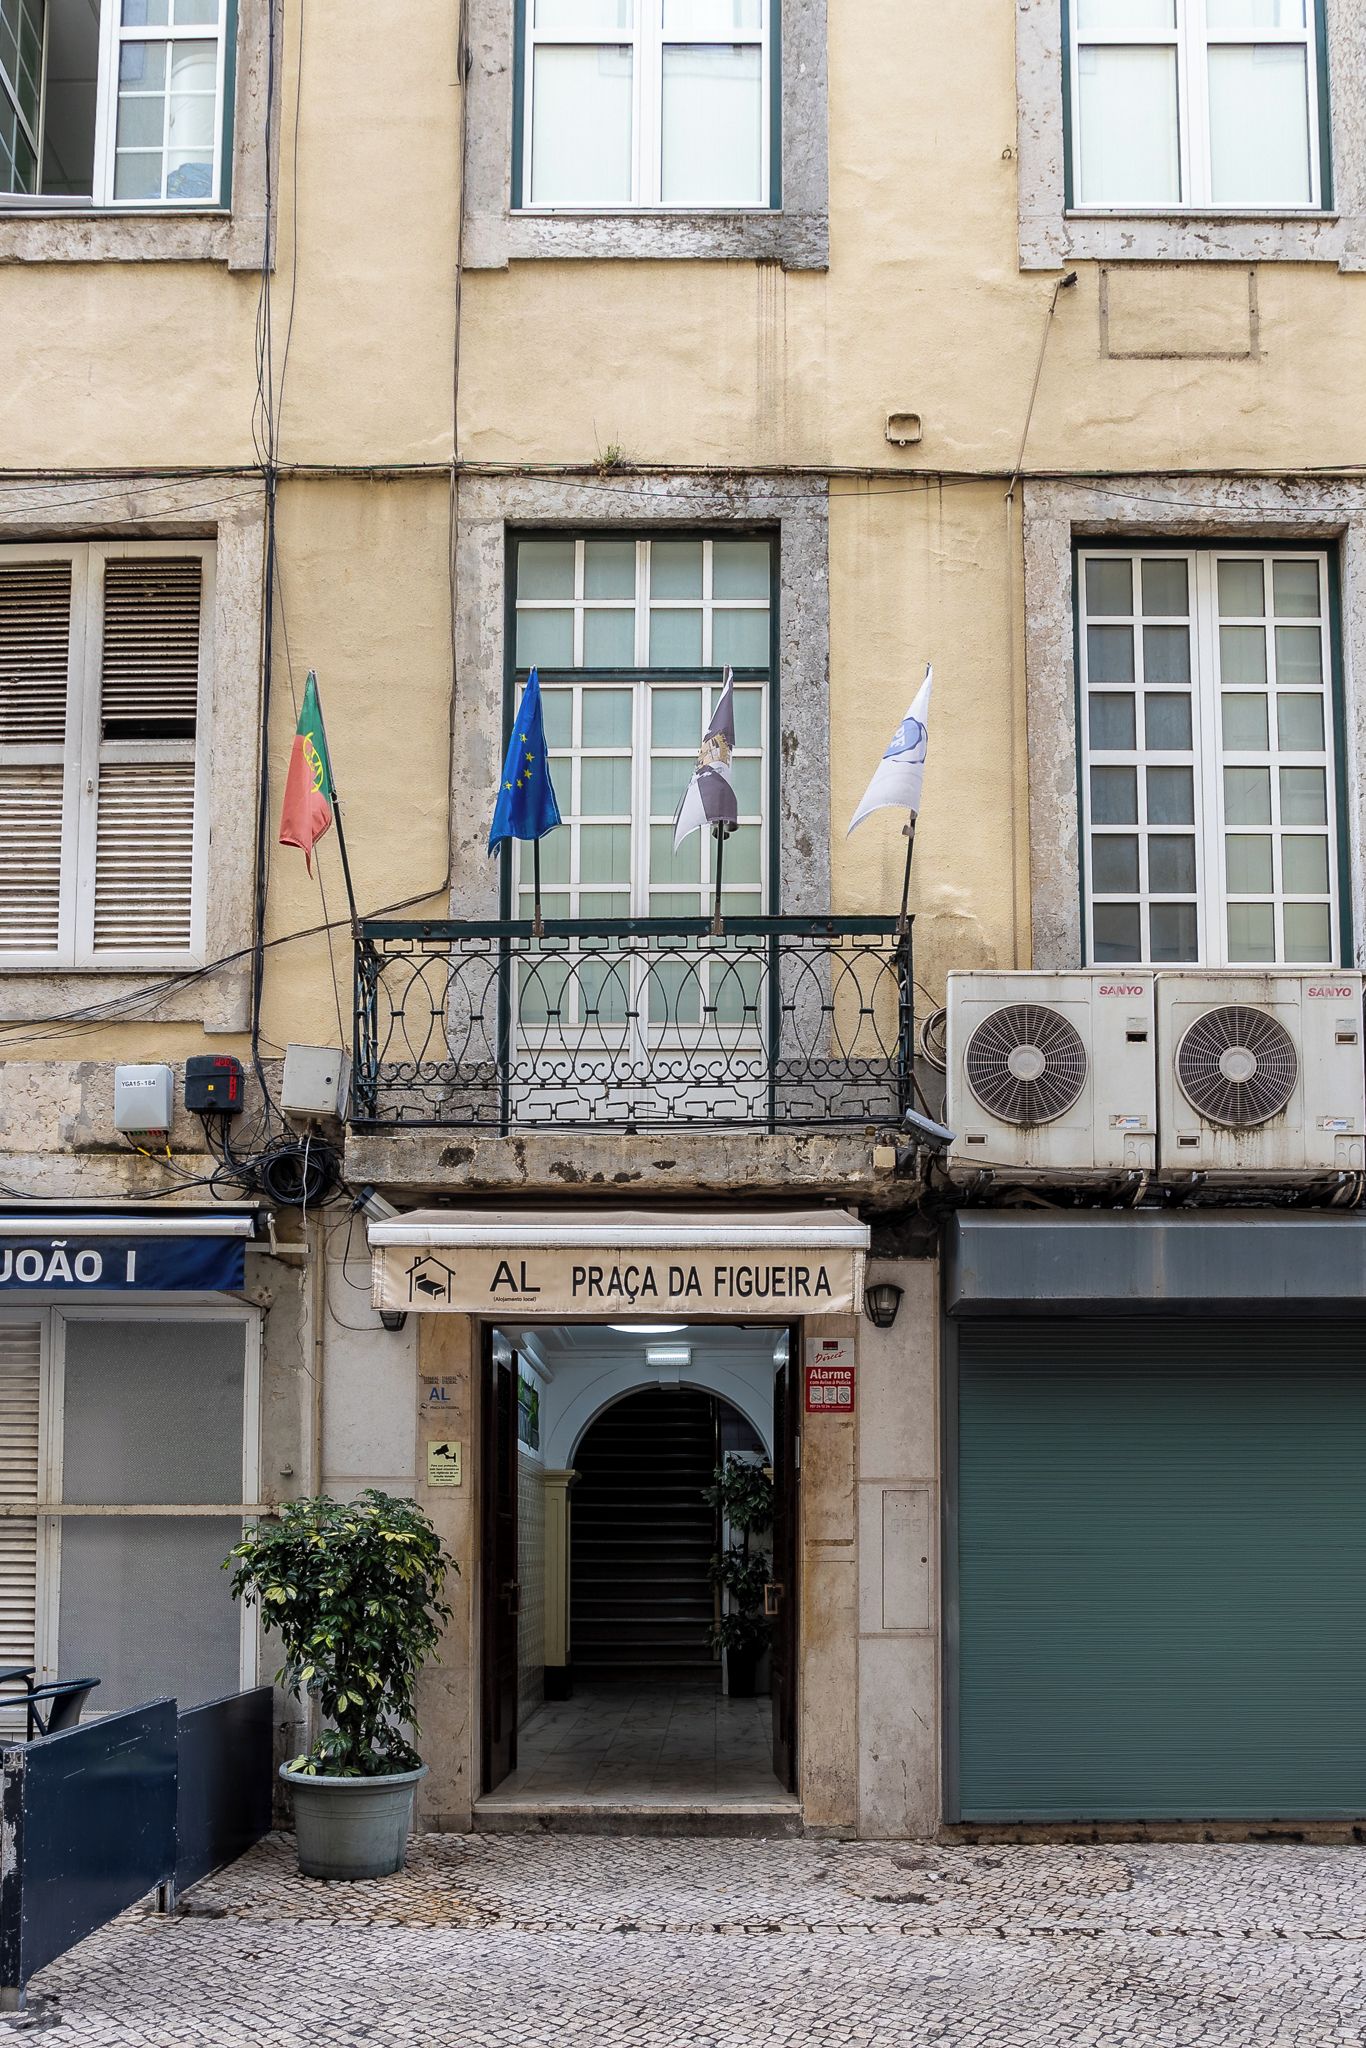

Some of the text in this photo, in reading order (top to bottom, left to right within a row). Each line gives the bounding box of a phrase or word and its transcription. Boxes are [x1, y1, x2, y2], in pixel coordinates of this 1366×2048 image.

[1099, 985, 1144, 996] SANYO
[1308, 987, 1352, 998] SANYO
[0, 1240, 137, 1283] JOÃO I
[489, 1260, 832, 1305] AL PRAÇA DA FIGUEIRA
[809, 1368, 852, 1380] Alarme
[429, 1386, 451, 1401] AL
